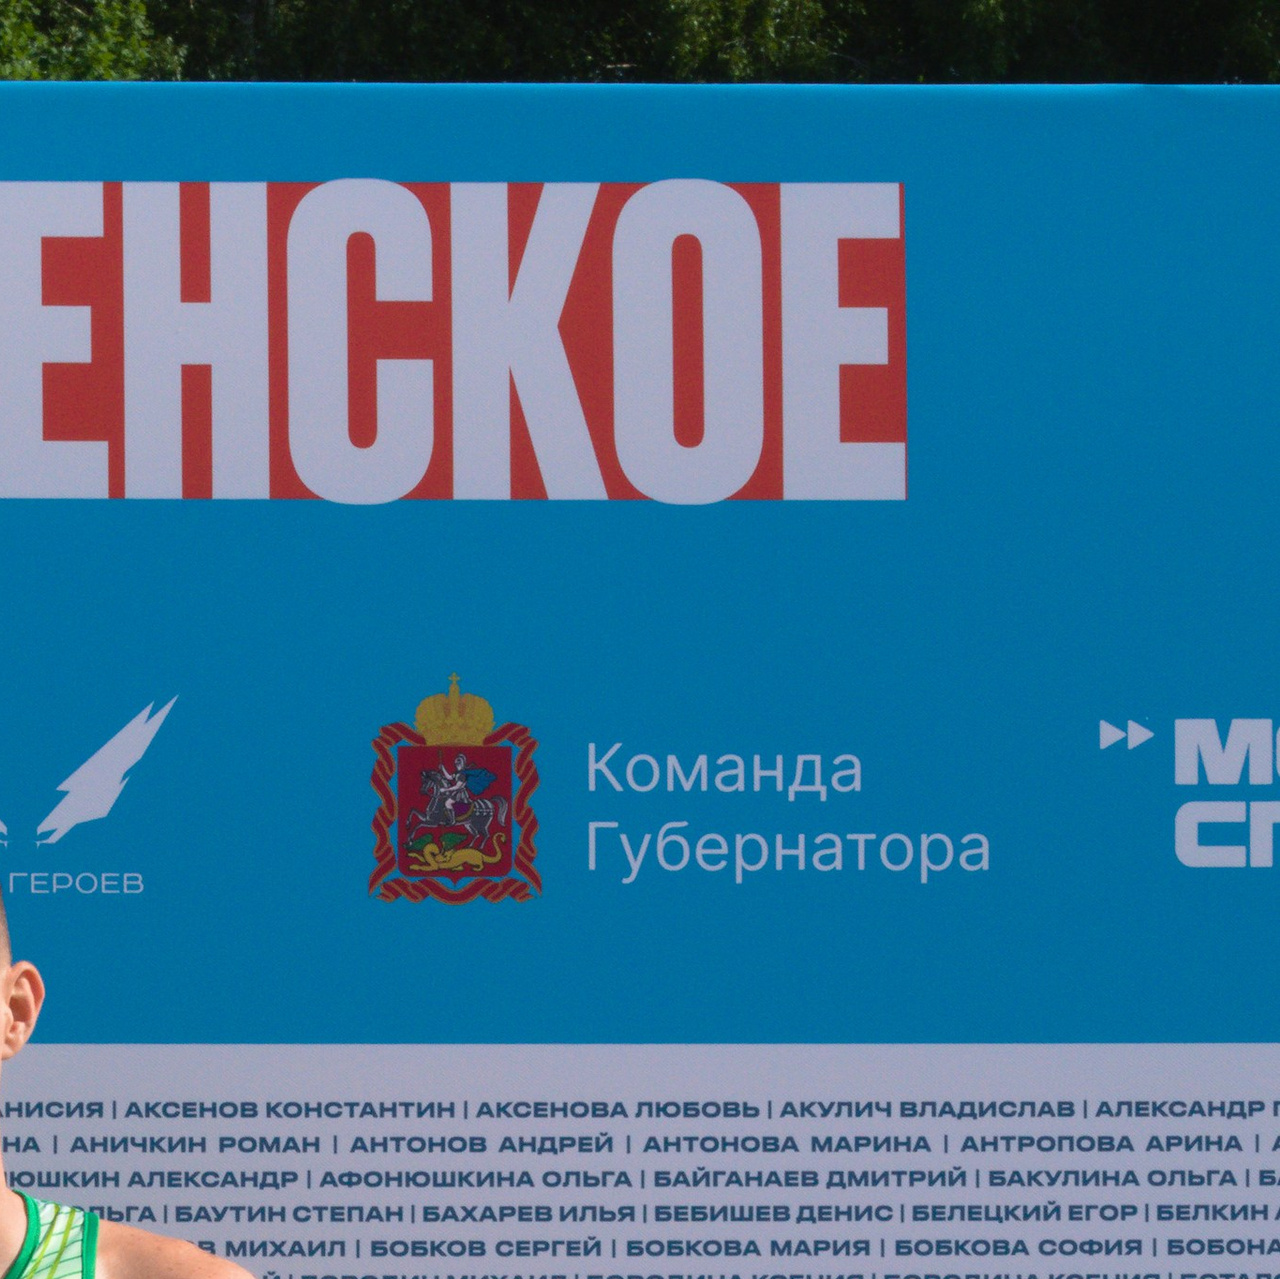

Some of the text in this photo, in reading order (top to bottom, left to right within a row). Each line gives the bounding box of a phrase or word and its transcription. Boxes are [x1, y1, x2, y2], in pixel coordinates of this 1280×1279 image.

[1175, 719, 1280, 784] М
[589, 743, 861, 801] Команда
[589, 822, 989, 884] Губернатора
[9, 872, 144, 893] ГЕРОЕВ
[476, 1102, 628, 1118] АКСЕНОВА
[635, 1102, 760, 1118] ЛЮБОВЬ
[643, 1136, 931, 1152] АНТОНОВА МАРИНА
[655, 1205, 893, 1223] БЕБИШЕВ ДЕНИС
